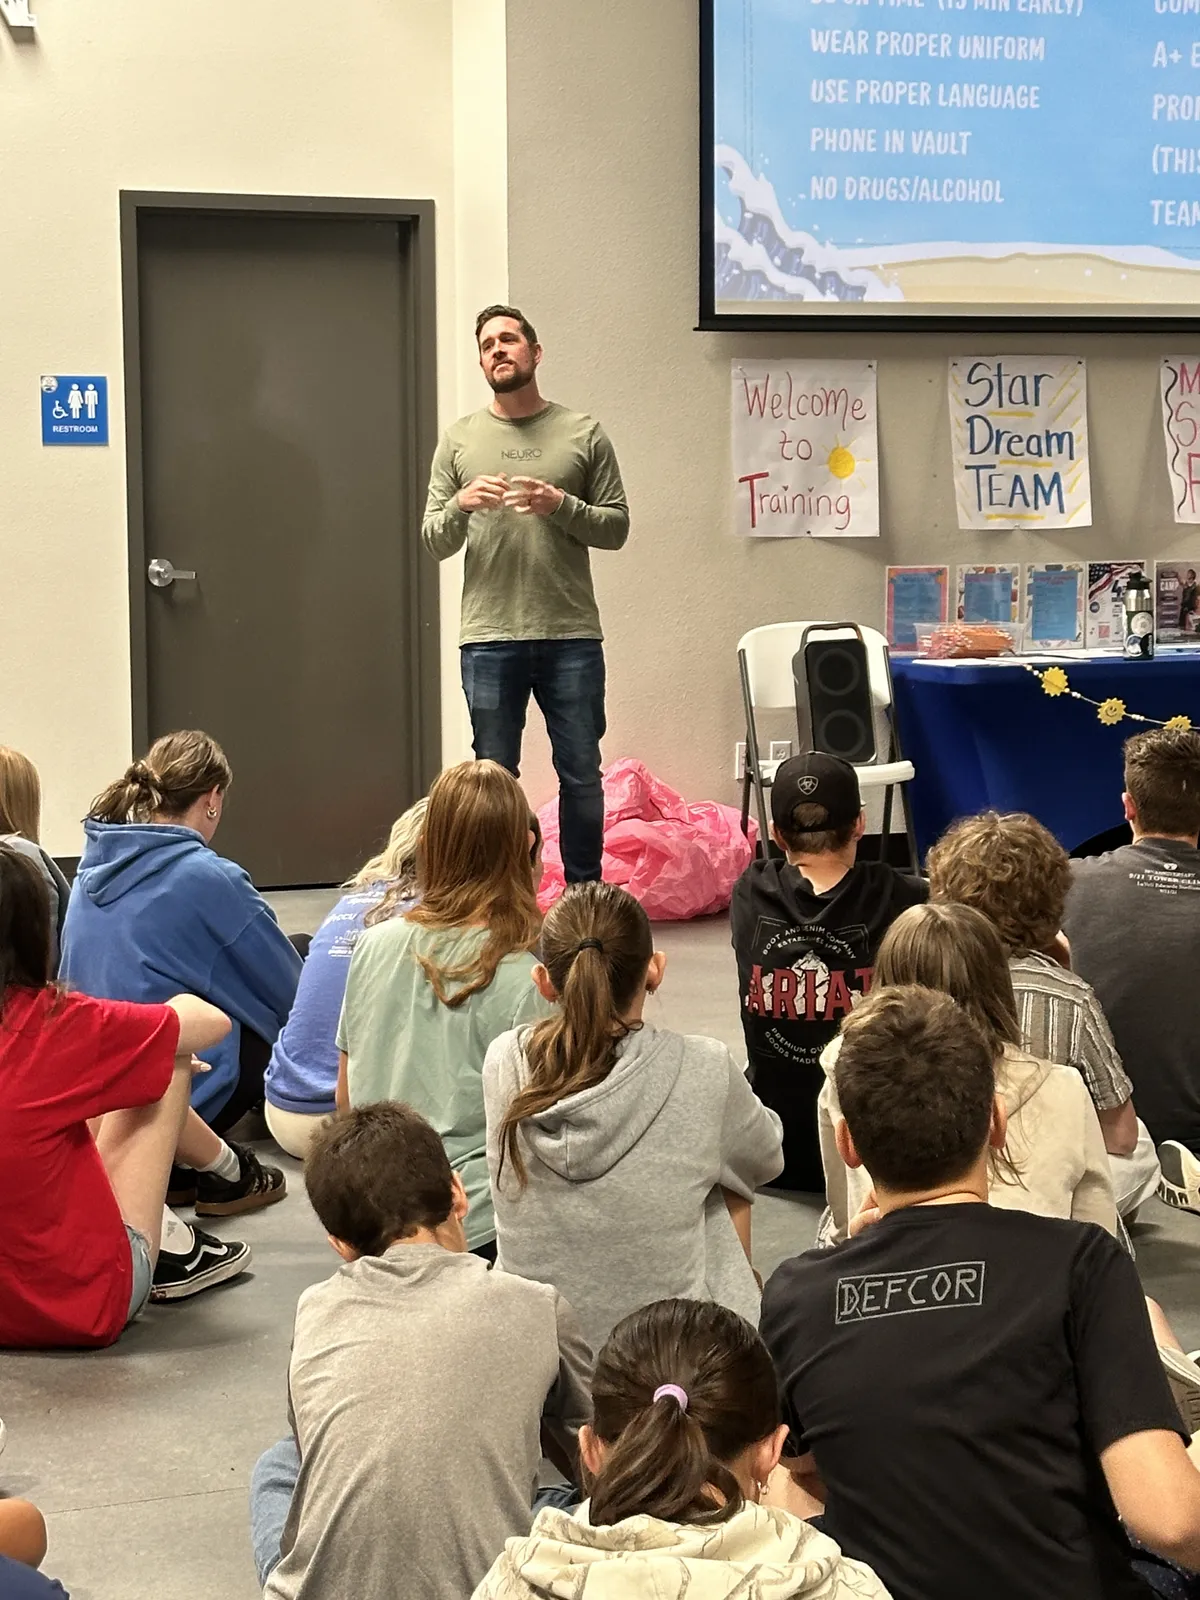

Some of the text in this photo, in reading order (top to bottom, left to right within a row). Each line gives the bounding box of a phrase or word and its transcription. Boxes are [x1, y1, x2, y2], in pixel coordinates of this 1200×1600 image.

[810, 28, 1045, 61] WEAR PROPER UNIFORM
[1152, 40, 1183, 68] A+
[810, 79, 1040, 109] USE PROPER LANGUAGE
[810, 127, 972, 155] PHONE IN VAULT
[811, 176, 1005, 203] NO DRUGS/ALCOHOL
[744, 371, 867, 431] Welcome
[964, 362, 1054, 408] Star
[52, 425, 99, 433] RESTROOM
[966, 414, 1074, 461] Dream
[501, 448, 542, 460] NEURO
[779, 430, 812, 461] to
[738, 472, 851, 531] Training
[964, 464, 1065, 514] TEAM
[1160, 580, 1180, 592] CAMP
[1148, 874, 1179, 883] TOWER
[762, 933, 781, 956] BOOT
[803, 925, 826, 933] ENIM
[826, 931, 857, 959] COMPANY
[748, 964, 876, 1021] ARIAT
[764, 1031, 817, 1065] GOODS MADE
[771, 1027, 807, 1054] PREMIUM
[840, 1268, 978, 1316] DEFCOR
